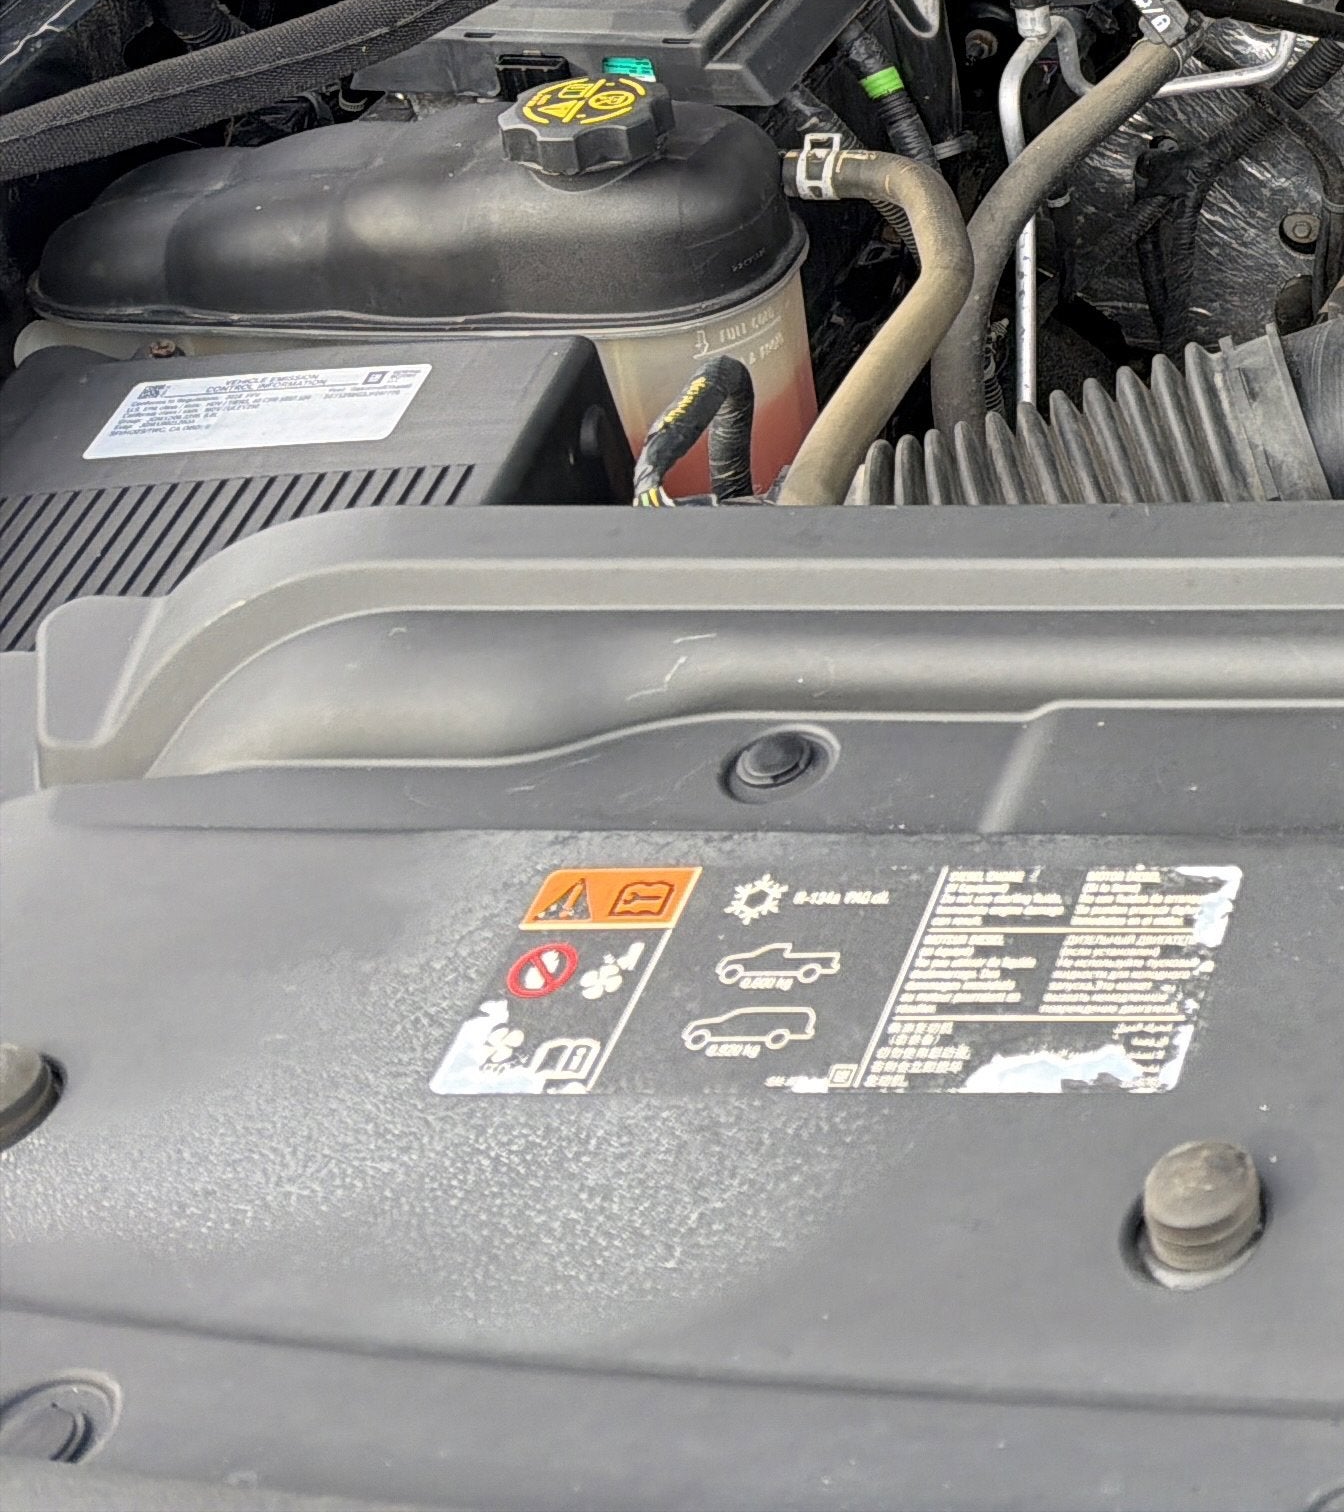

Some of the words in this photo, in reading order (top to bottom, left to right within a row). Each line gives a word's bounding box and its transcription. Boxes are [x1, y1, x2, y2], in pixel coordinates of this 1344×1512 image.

[206, 383, 252, 393] CONTROL
[257, 379, 327, 390] INFORMATION
[225, 376, 268, 386] VEHICLE
[270, 374, 320, 383] EMISSION
